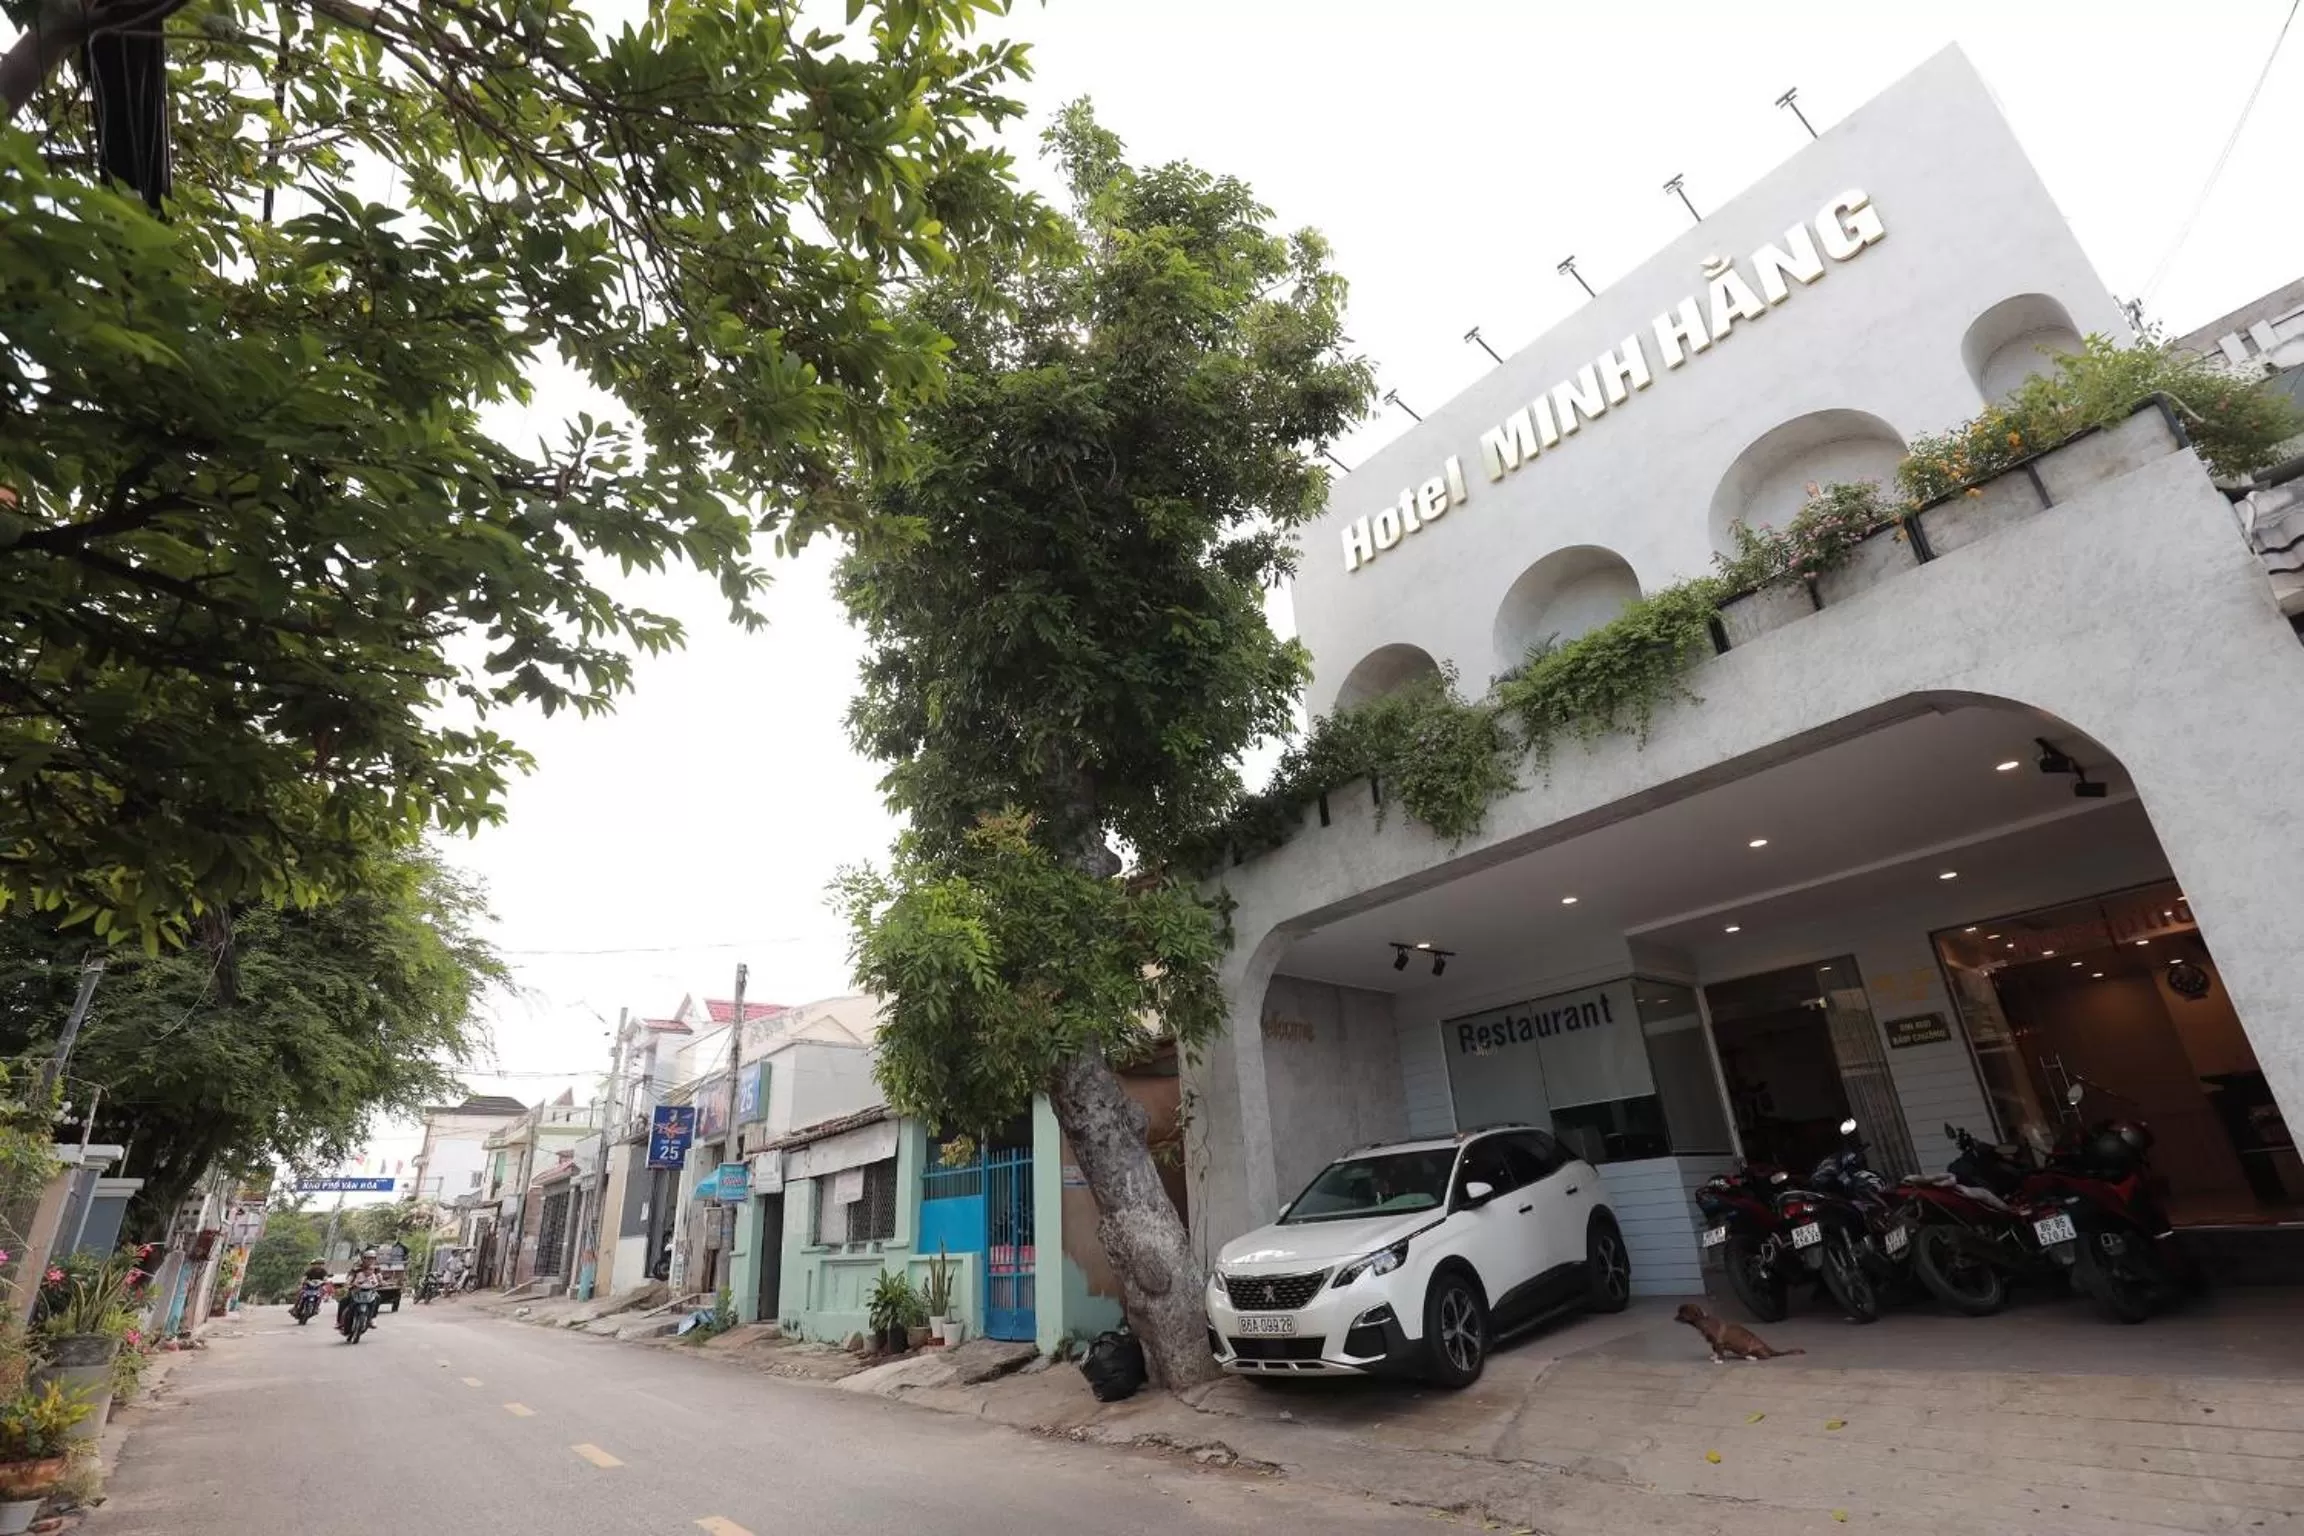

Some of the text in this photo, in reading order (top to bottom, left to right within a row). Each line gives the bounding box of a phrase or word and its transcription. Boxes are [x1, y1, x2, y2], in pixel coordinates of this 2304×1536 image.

[1341, 454, 1468, 573] Hotel
[1480, 333, 1653, 484] MINH
[1457, 992, 1613, 1054] Restaurant
[660, 1145, 679, 1160] 25
